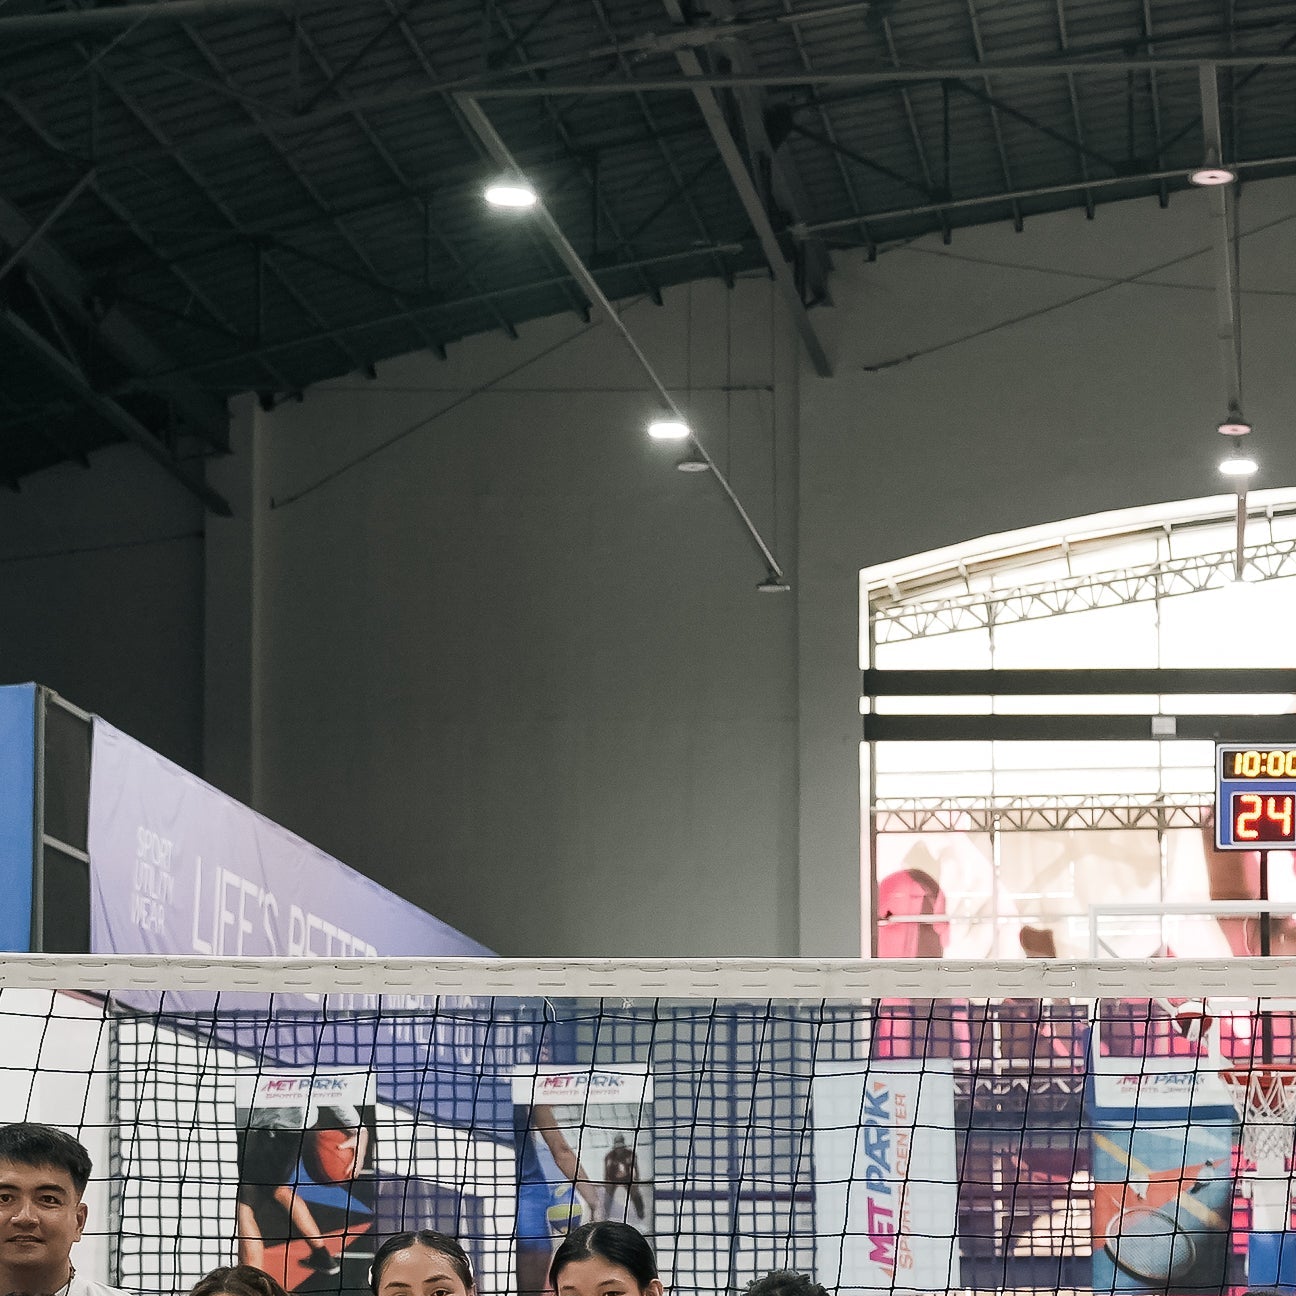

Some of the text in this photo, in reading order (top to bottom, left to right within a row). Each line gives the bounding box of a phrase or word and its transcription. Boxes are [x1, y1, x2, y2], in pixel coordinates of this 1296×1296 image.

[1237, 794, 1292, 838] 24
[267, 1079, 297, 1091] MET
[544, 1076, 574, 1088] MET
[864, 1089, 894, 1265] MET PARK
